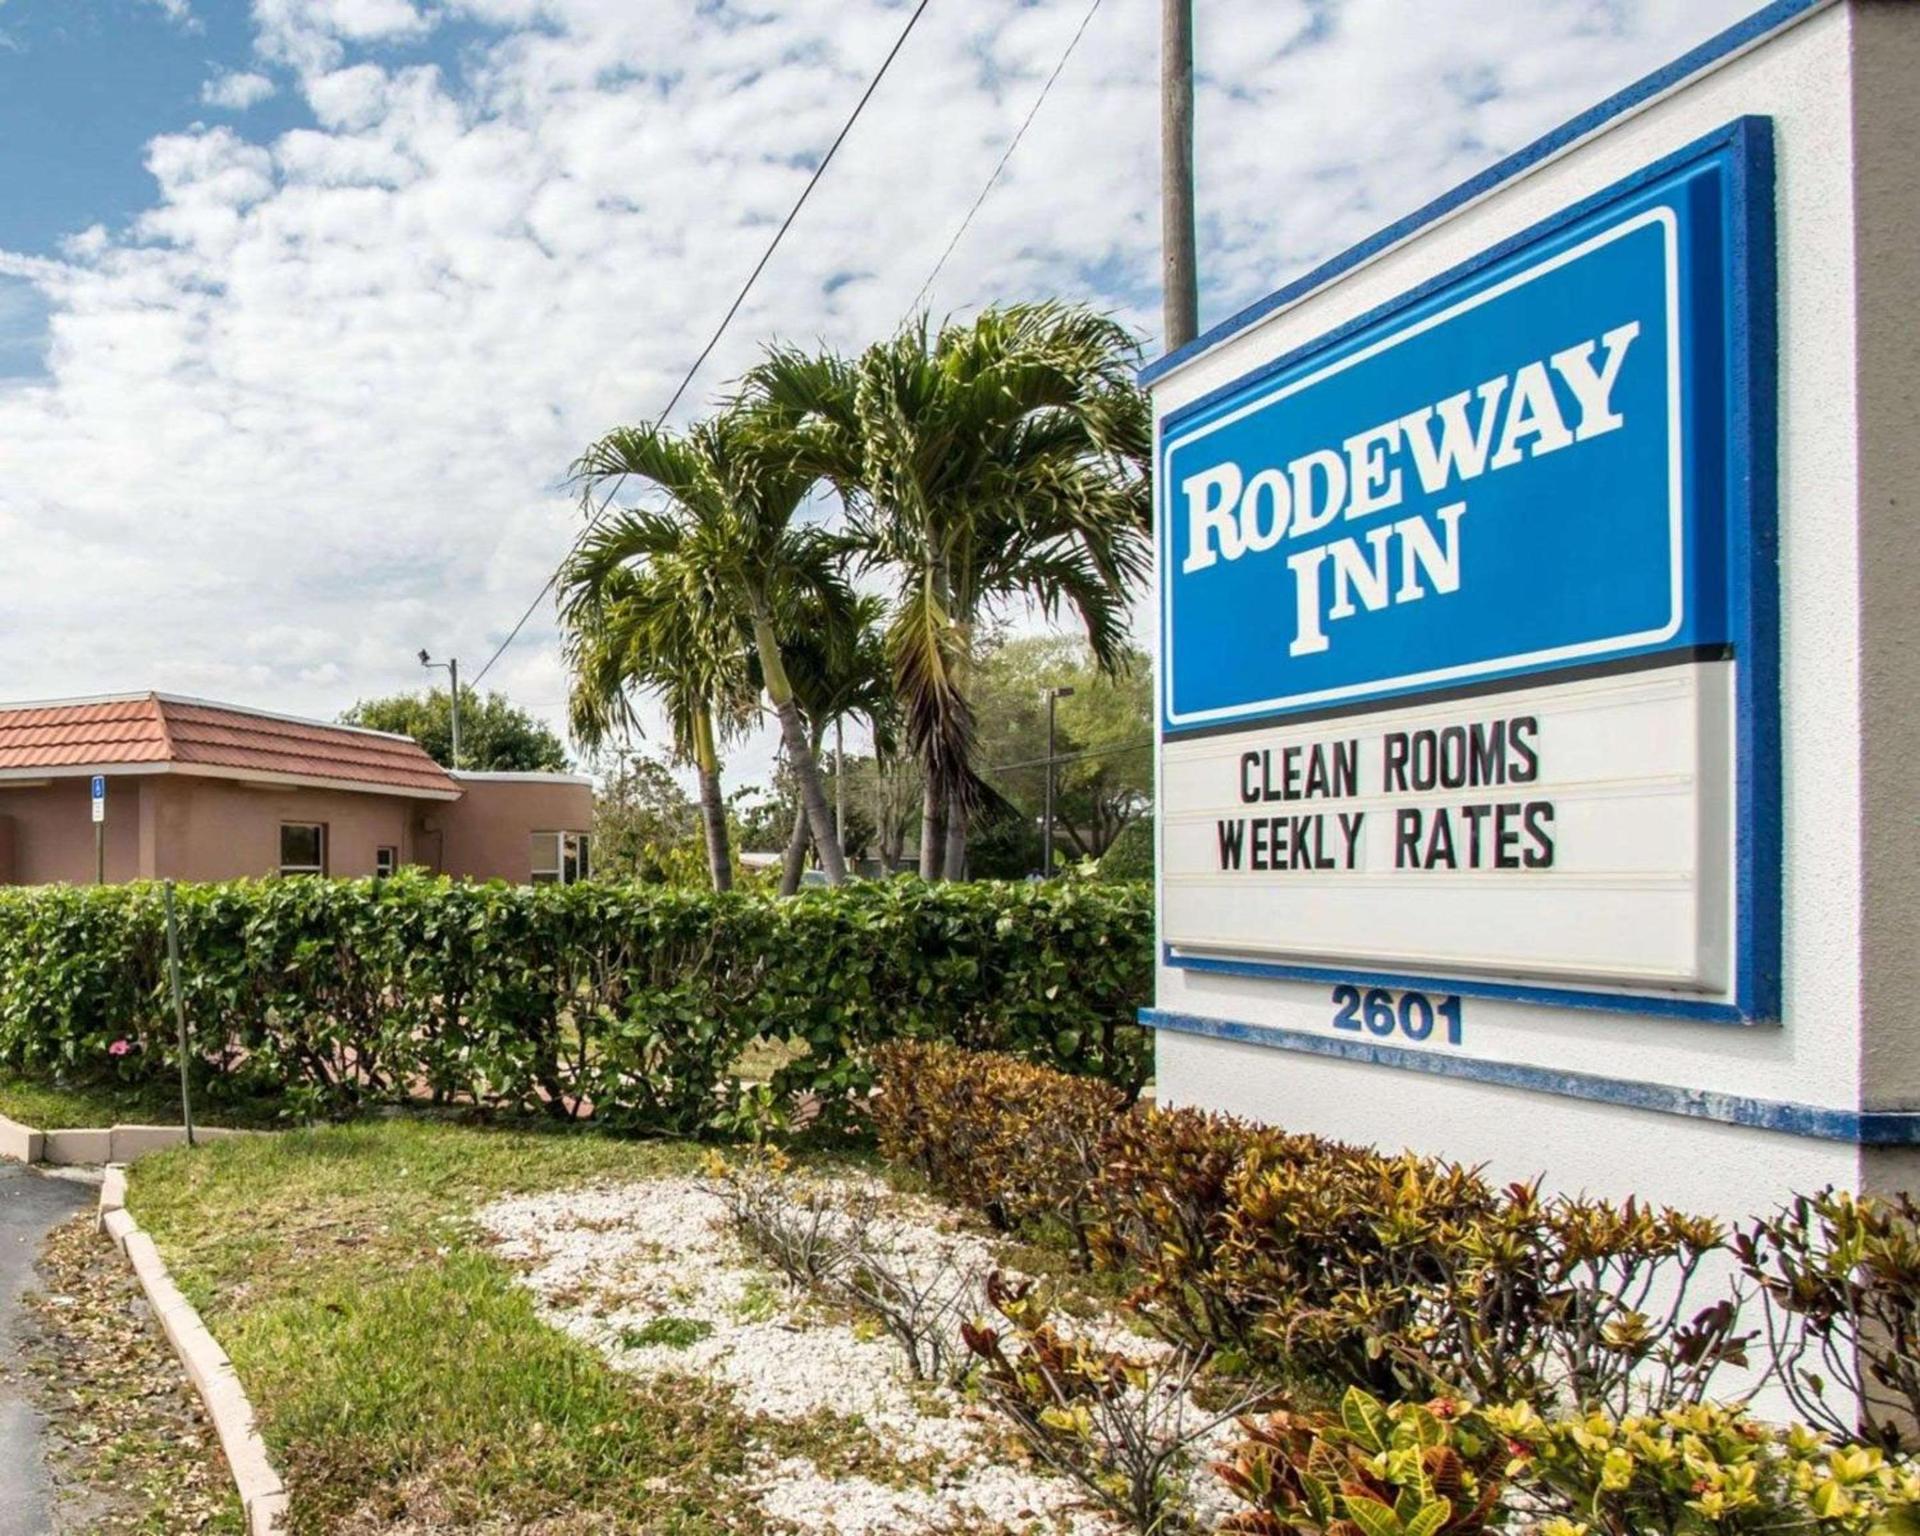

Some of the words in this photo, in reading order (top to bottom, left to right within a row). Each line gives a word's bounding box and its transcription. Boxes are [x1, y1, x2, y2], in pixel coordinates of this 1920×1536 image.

[1182, 320, 1640, 574] RODEWAY
[1286, 502, 1466, 657] INN
[1240, 739, 1358, 803] CLEAN
[1383, 716, 1539, 793] ROOMS
[1218, 811, 1364, 870] WEEKLY
[1396, 801, 1554, 869] RATES
[1332, 984, 1462, 1045] 2601
